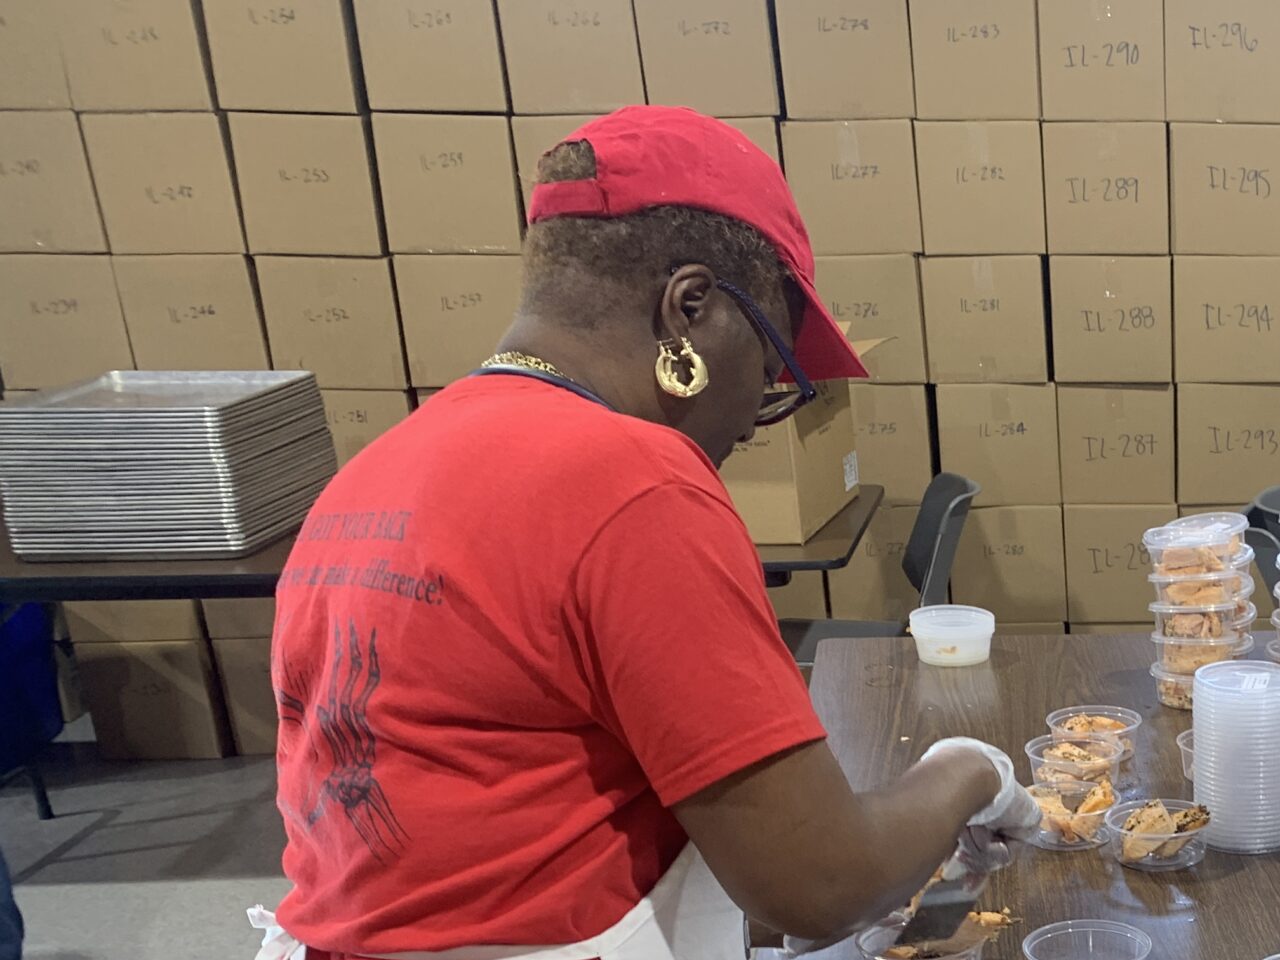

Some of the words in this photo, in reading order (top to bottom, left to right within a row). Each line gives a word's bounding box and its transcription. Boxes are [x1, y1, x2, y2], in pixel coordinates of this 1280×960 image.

[1188, 22, 1259, 53] IL-296
[1063, 41, 1140, 69] IL-290
[1067, 176, 1140, 204] IL-289
[1206, 164, 1272, 199] IL-295
[1080, 305, 1156, 334] IL-288
[1203, 303, 1275, 333] IL-294
[1082, 432, 1158, 463] IL-287
[1207, 425, 1280, 456] IL-293
[360, 557, 445, 606] difference!
